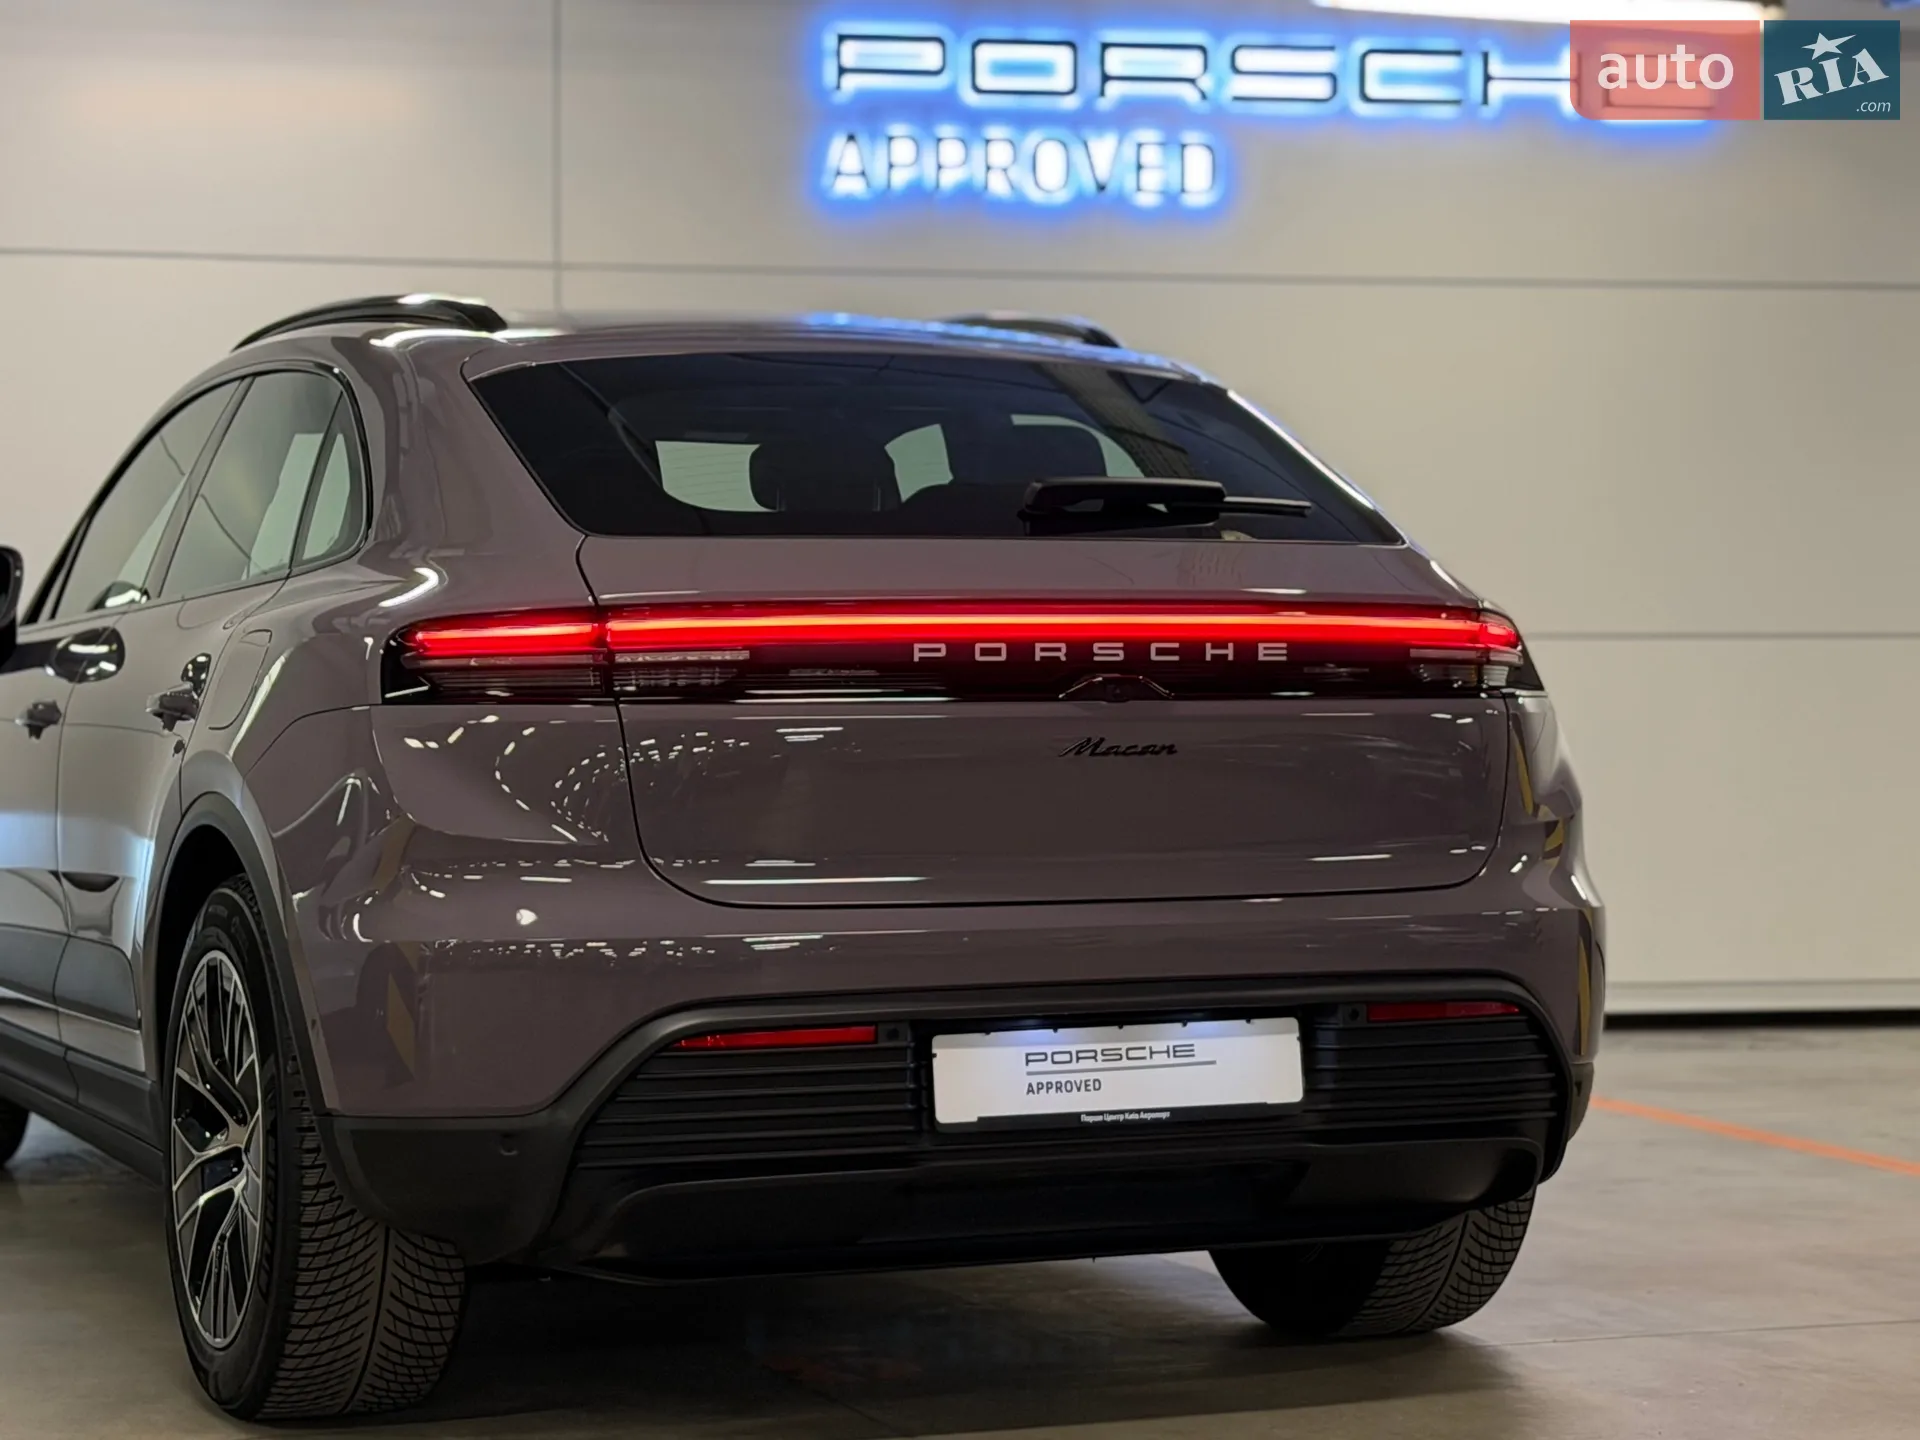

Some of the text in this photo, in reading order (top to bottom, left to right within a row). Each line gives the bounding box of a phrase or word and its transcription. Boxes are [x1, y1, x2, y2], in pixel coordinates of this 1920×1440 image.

[834, 30, 1716, 113] PORSCHE
[831, 131, 1217, 196] APPROVED
[912, 642, 1288, 662] PORSCHE
[1058, 736, 1178, 758] Macan
[1024, 1043, 1196, 1067] PORSCHE
[1026, 1078, 1102, 1096] APPROVED
